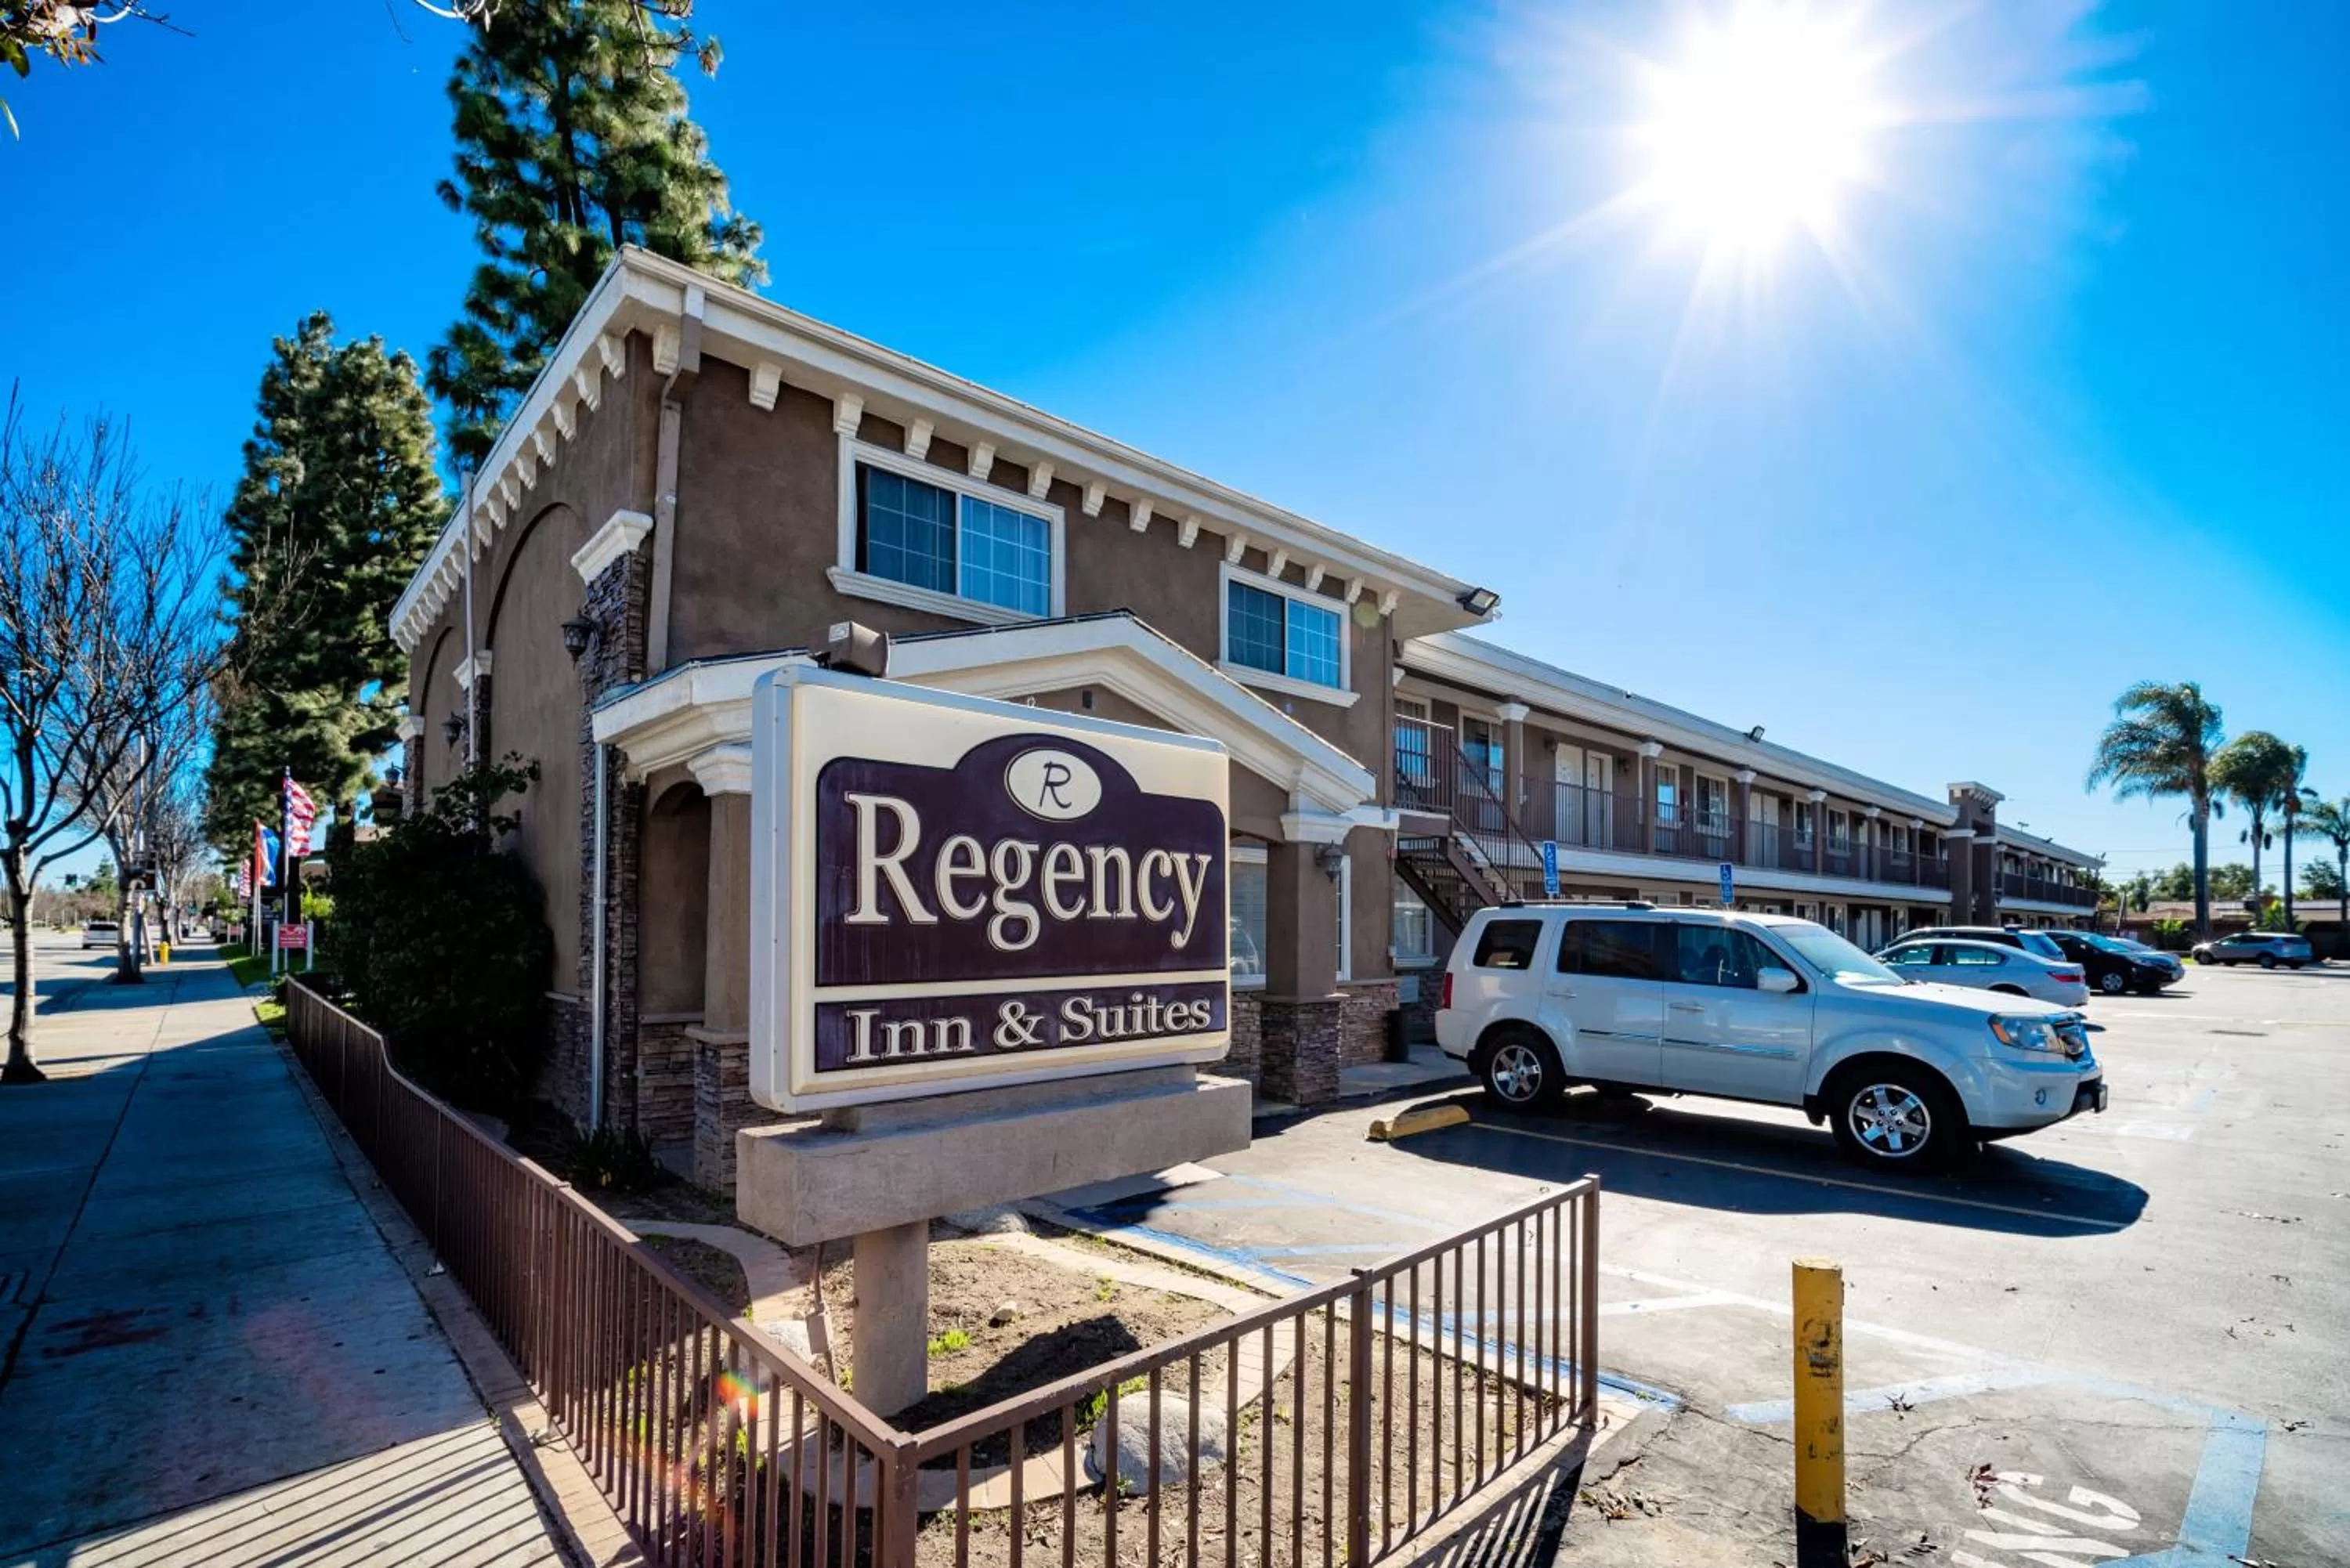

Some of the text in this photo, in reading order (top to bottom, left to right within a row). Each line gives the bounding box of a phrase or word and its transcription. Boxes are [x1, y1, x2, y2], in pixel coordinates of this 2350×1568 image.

[843, 790, 1213, 952] Regency
[845, 990, 1212, 1064] Inn & Suites
